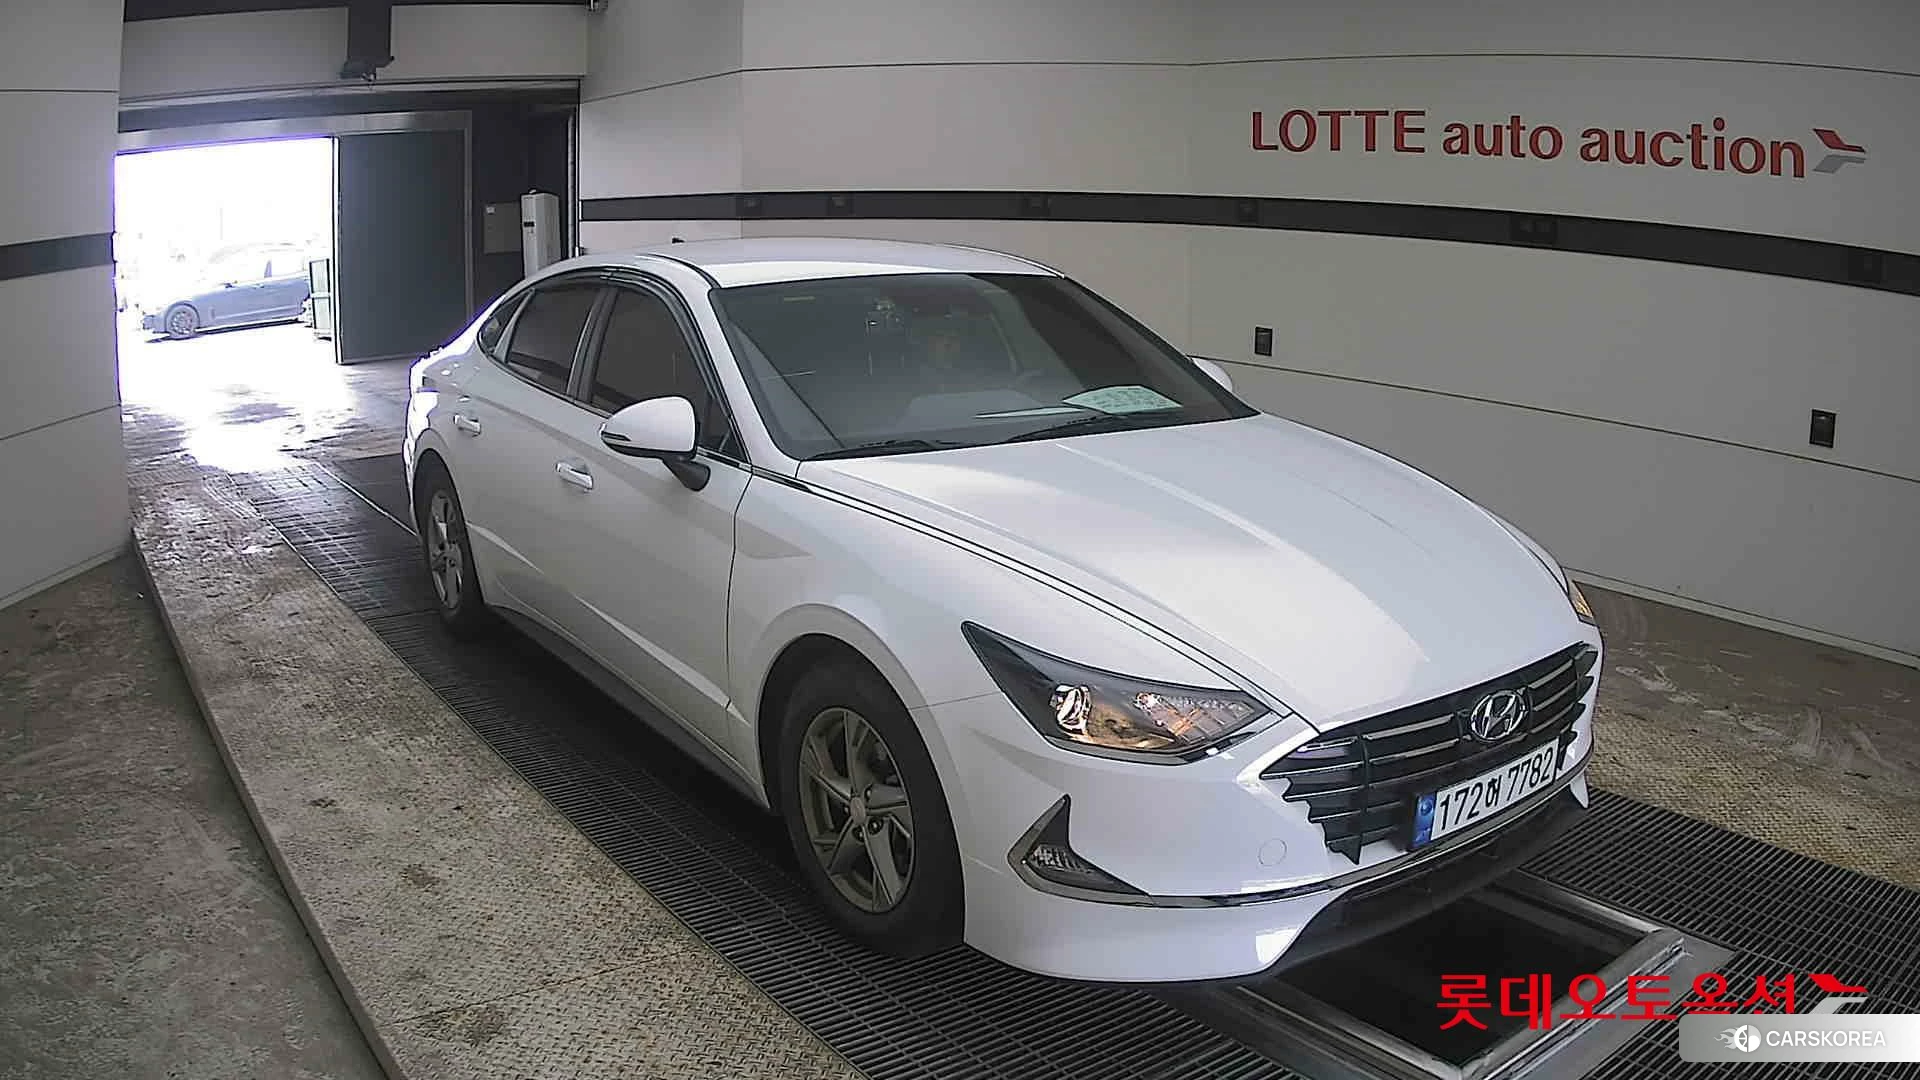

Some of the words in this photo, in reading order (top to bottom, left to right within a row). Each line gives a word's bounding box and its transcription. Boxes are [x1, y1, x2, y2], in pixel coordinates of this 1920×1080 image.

[1252, 110, 1426, 153] LOTTE
[1442, 115, 1563, 160] auto
[1579, 117, 1806, 178] auction
[1507, 746, 1555, 801] 7782
